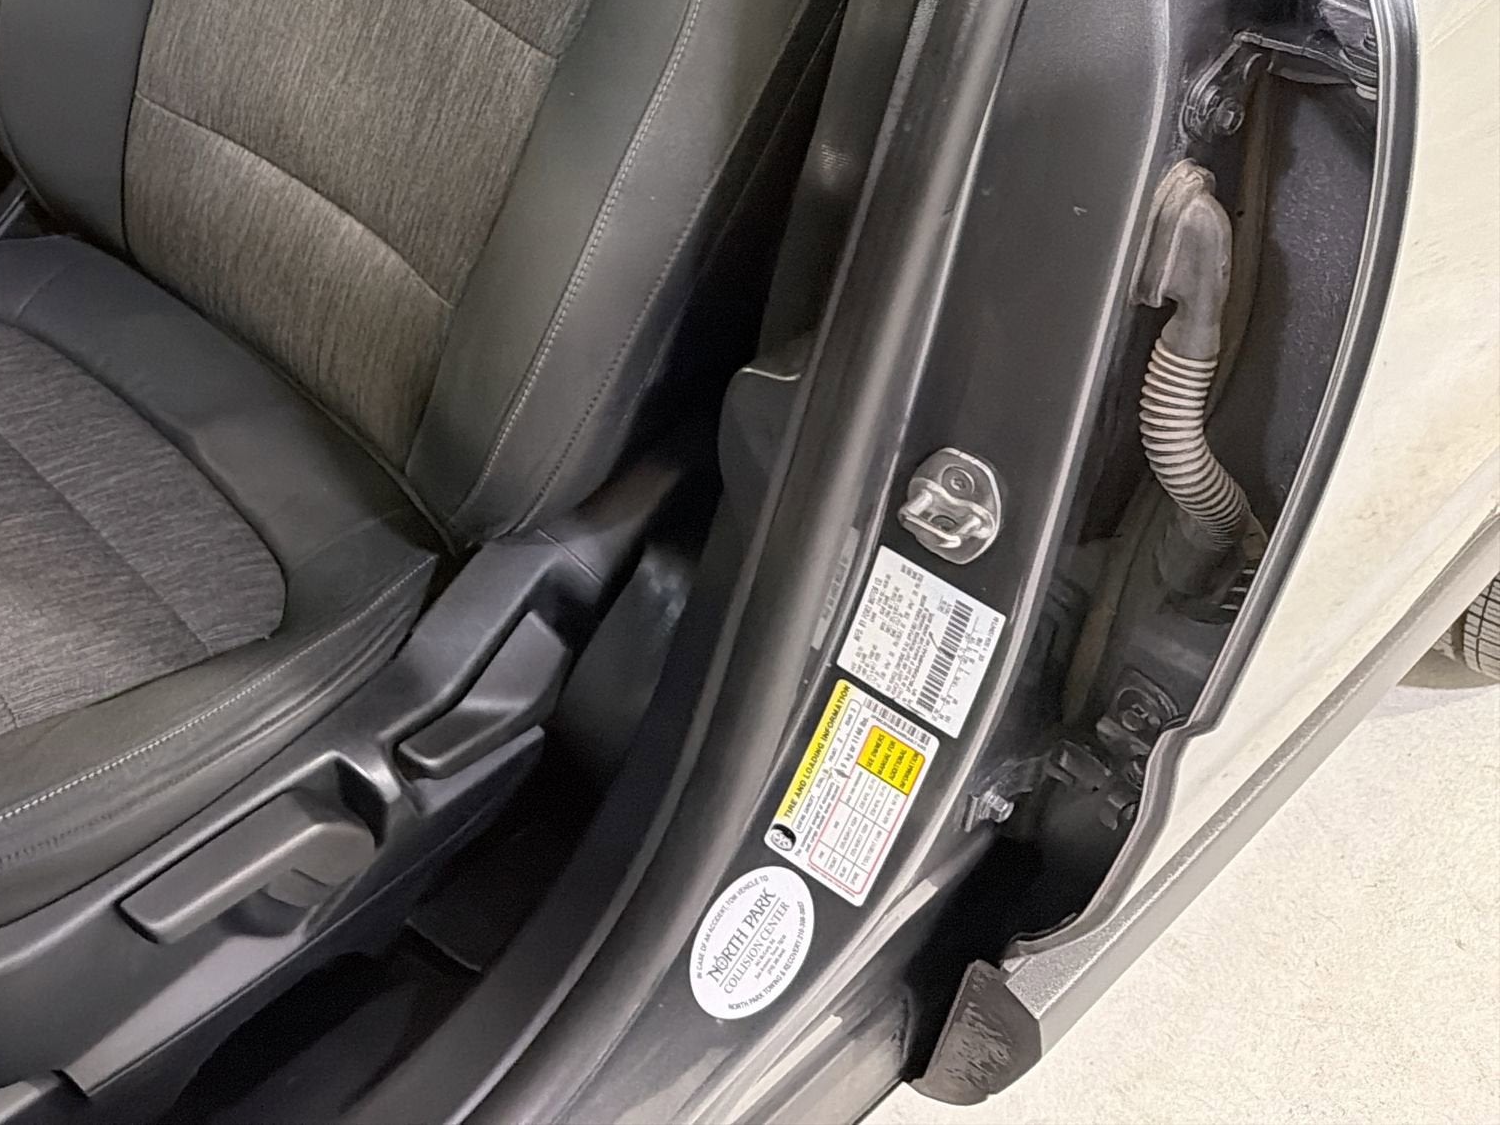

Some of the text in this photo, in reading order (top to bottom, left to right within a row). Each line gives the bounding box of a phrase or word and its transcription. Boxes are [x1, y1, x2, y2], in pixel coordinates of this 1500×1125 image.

[783, 798, 798, 818] TIRE
[792, 779, 807, 799] AND
[801, 741, 825, 778] LOADING
[818, 684, 852, 741] INFORMATION
[886, 739, 896, 752] FOR
[705, 886, 777, 982] NORTH PARK
[722, 900, 790, 995] COLLISION CENTER
[748, 992, 764, 1004] PARK
[762, 974, 782, 994] TOWING
[782, 939, 801, 971] RECOVERY
